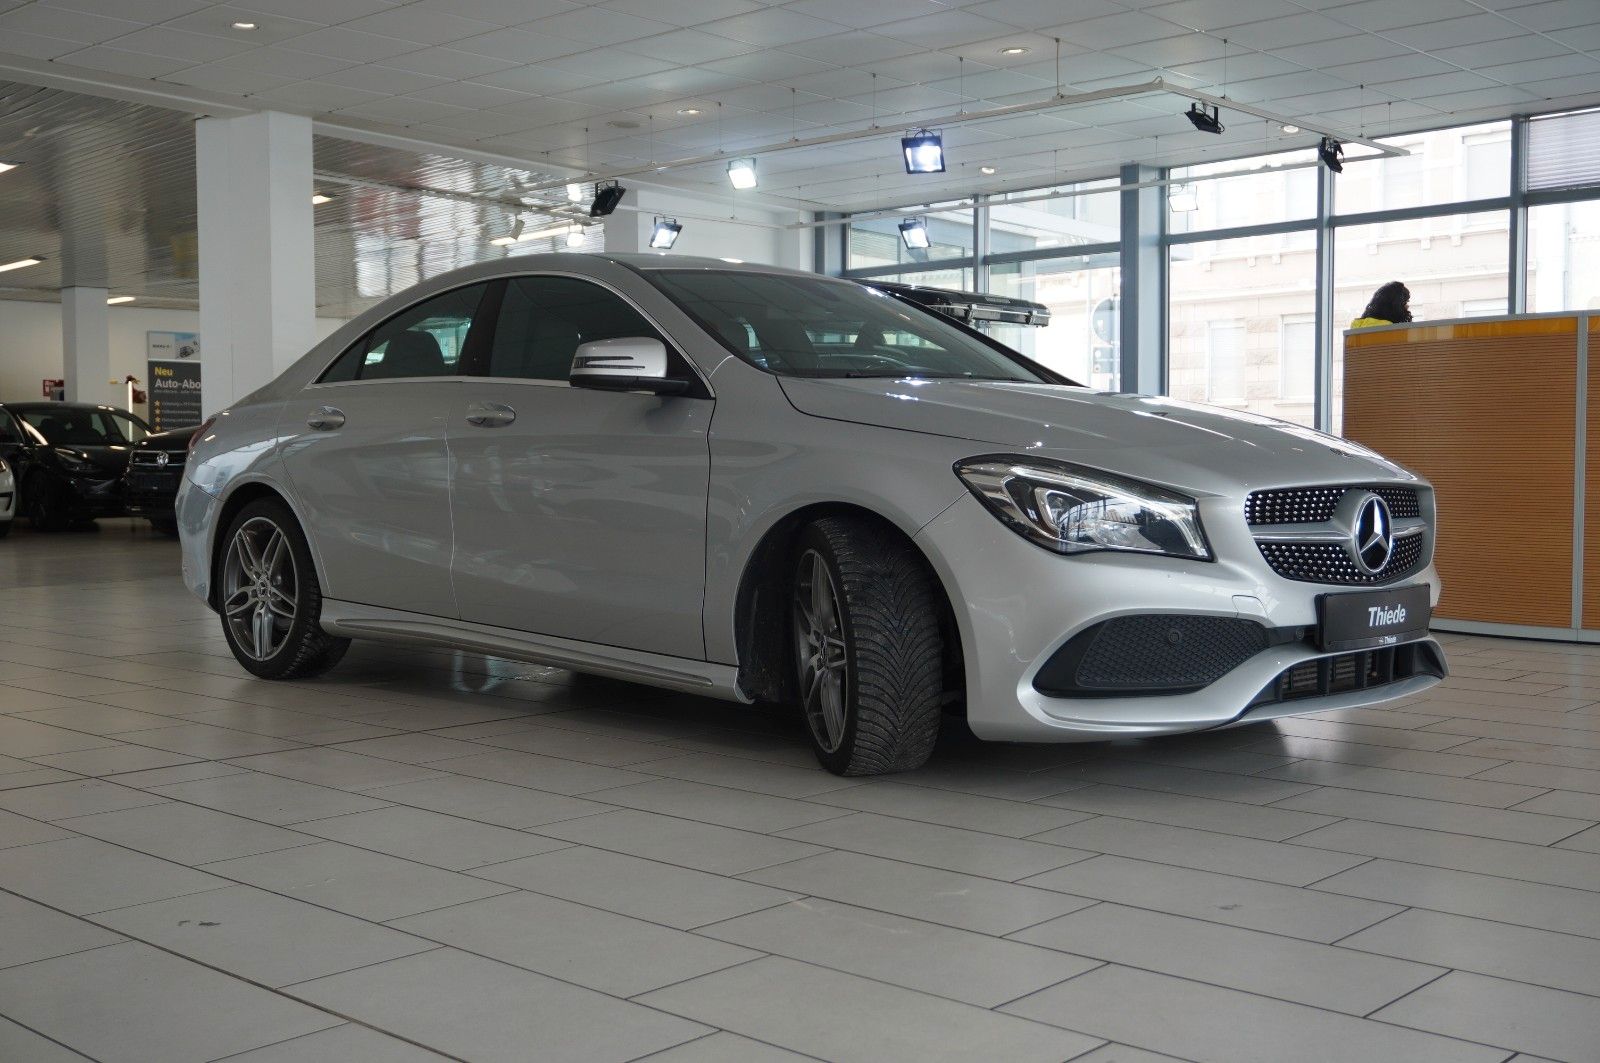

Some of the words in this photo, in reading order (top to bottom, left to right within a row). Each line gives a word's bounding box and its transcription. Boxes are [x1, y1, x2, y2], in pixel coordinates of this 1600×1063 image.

[155, 366, 173, 376] Neu
[155, 378, 201, 389] Auto-Abo
[1368, 604, 1406, 627] Thiede
